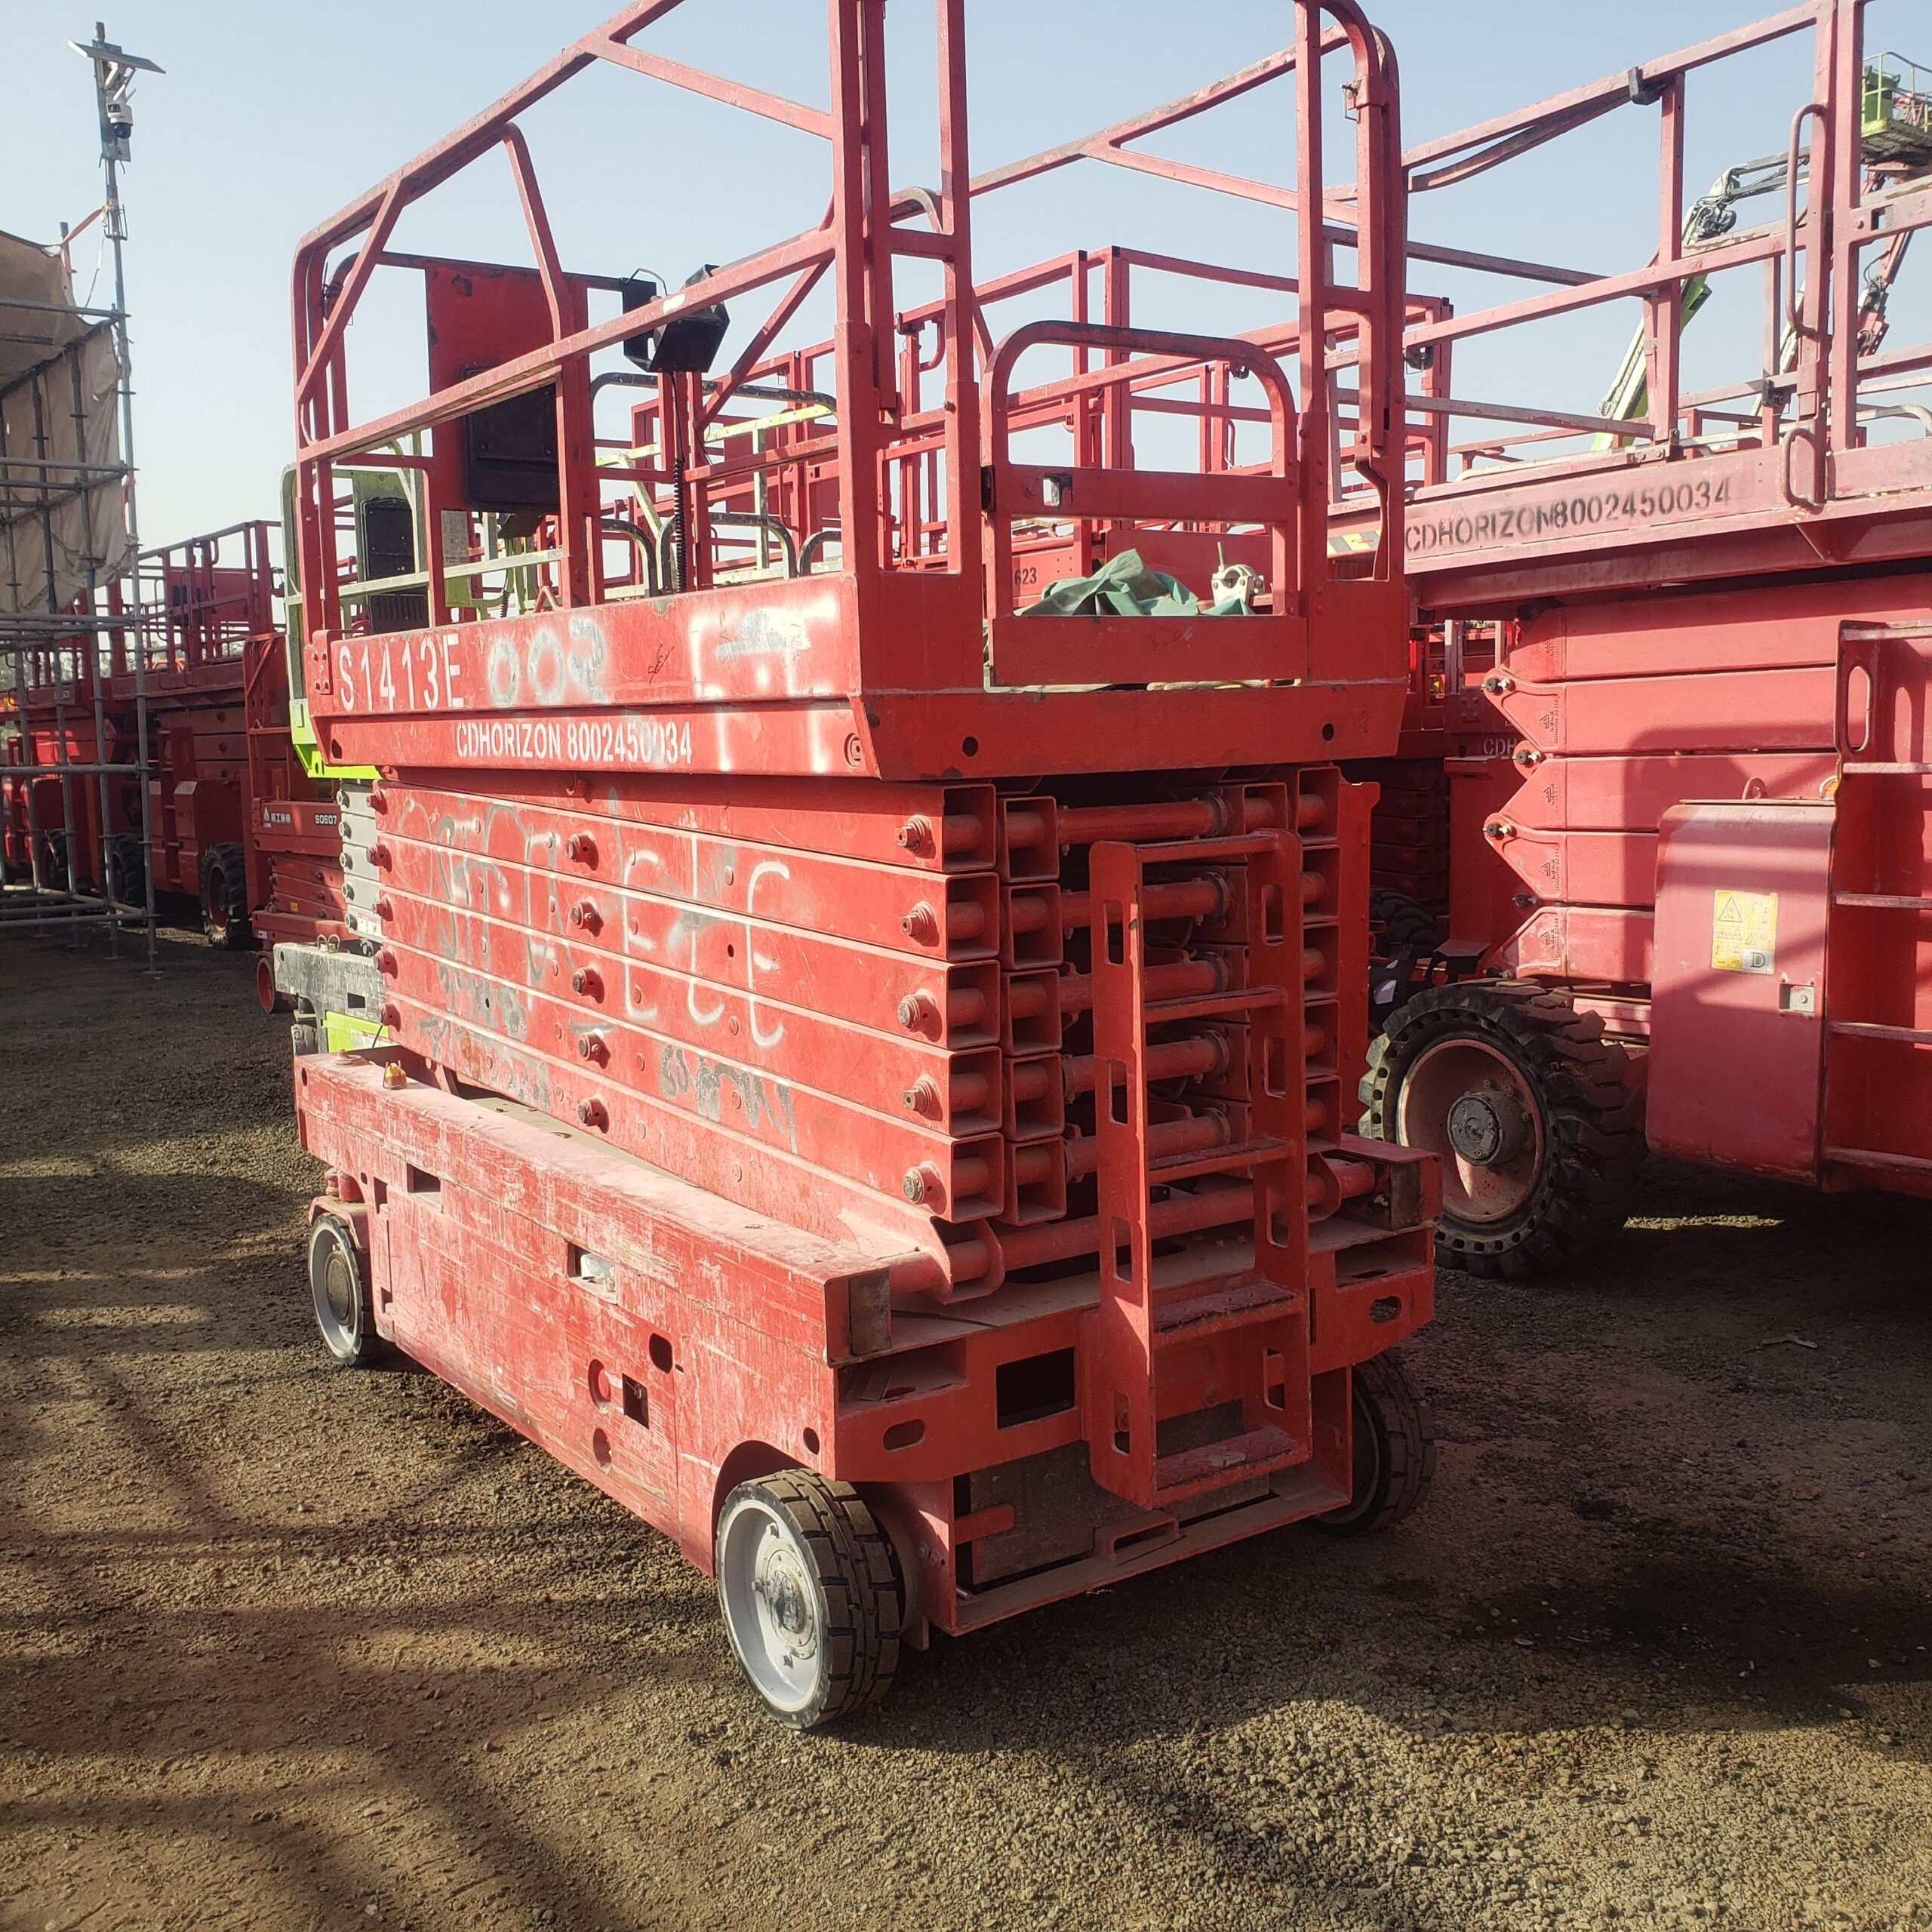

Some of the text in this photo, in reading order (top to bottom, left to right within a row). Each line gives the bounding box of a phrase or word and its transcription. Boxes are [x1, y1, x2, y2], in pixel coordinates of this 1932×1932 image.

[1014, 567, 1037, 586] 623
[339, 633, 464, 712] S1413E
[456, 721, 693, 764] CDHORIZON 8002450034
